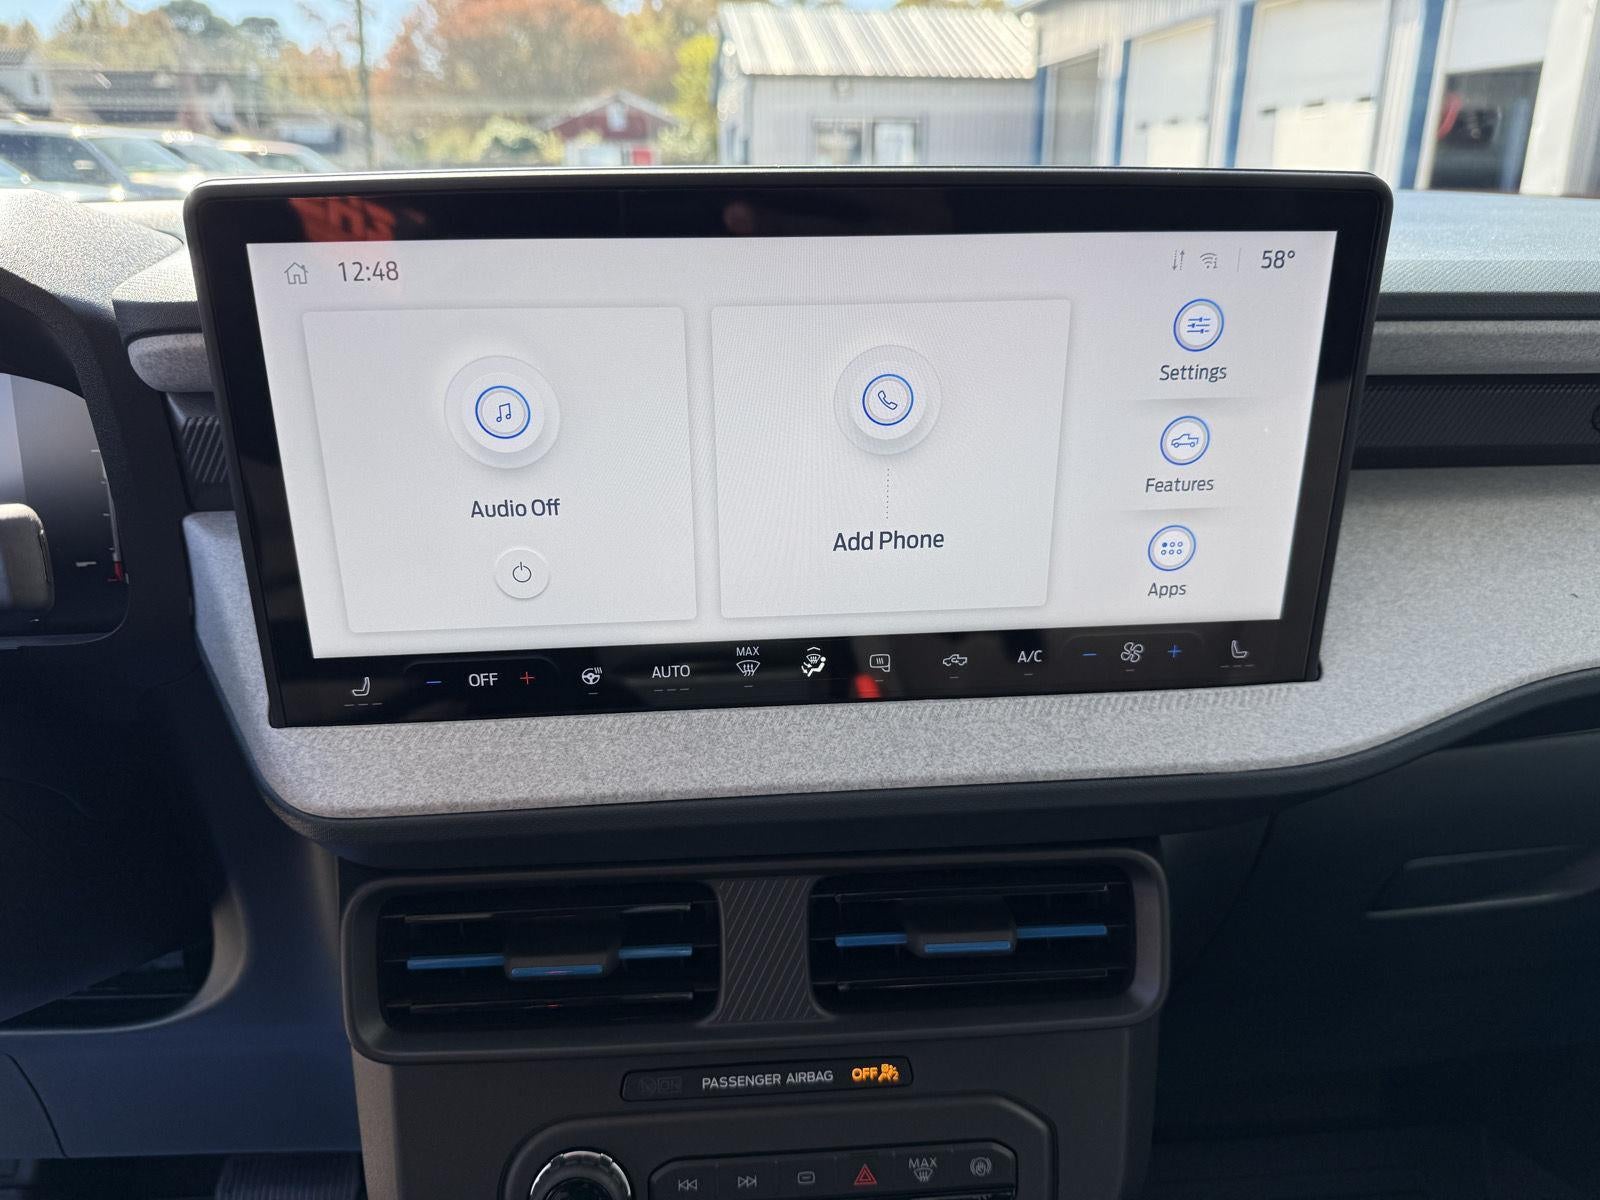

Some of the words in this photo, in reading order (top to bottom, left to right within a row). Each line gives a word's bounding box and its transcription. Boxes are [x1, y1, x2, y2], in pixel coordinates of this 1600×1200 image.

[1261, 250, 1295, 269] 58°
[337, 260, 399, 282] 12:48
[1159, 363, 1227, 383] Settings
[1145, 477, 1214, 493] Features
[470, 500, 527, 518] Audio
[531, 499, 561, 517] Off
[833, 531, 874, 552] Add
[878, 529, 945, 550] Phone
[1147, 582, 1187, 598] Apps
[736, 646, 760, 657] MAX
[1017, 649, 1043, 664] A/C
[468, 672, 499, 687] OFF
[652, 664, 691, 679] AUTO
[702, 1075, 782, 1090] PASSENGER
[785, 1069, 833, 1084] AIRBAG
[851, 1066, 878, 1082] OFF
[908, 1157, 937, 1170] MAX
